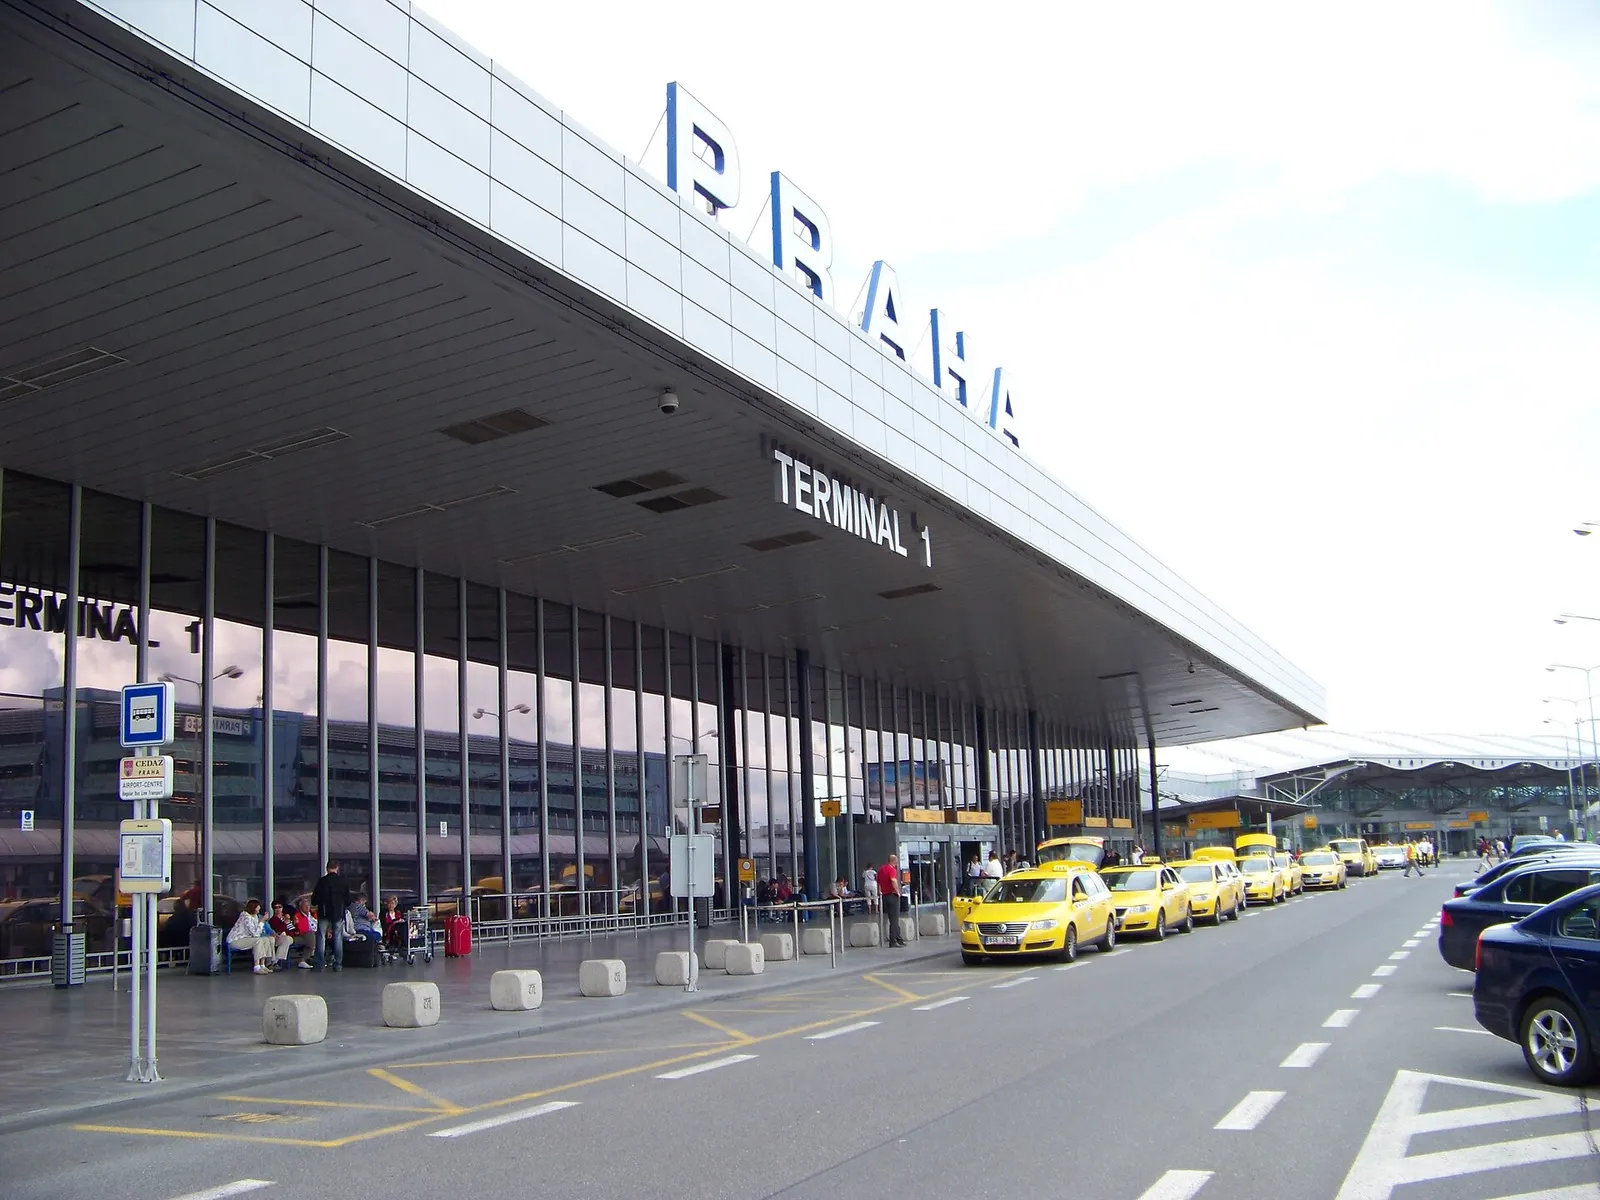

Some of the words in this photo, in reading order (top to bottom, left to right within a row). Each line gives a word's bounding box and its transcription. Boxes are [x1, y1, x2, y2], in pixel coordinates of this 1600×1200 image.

[666, 81, 1021, 448] PRAHA
[774, 449, 908, 558] TERMINAL
[921, 525, 932, 568] 1
[185, 621, 202, 654] 1
[135, 759, 164, 768] CEDAZ
